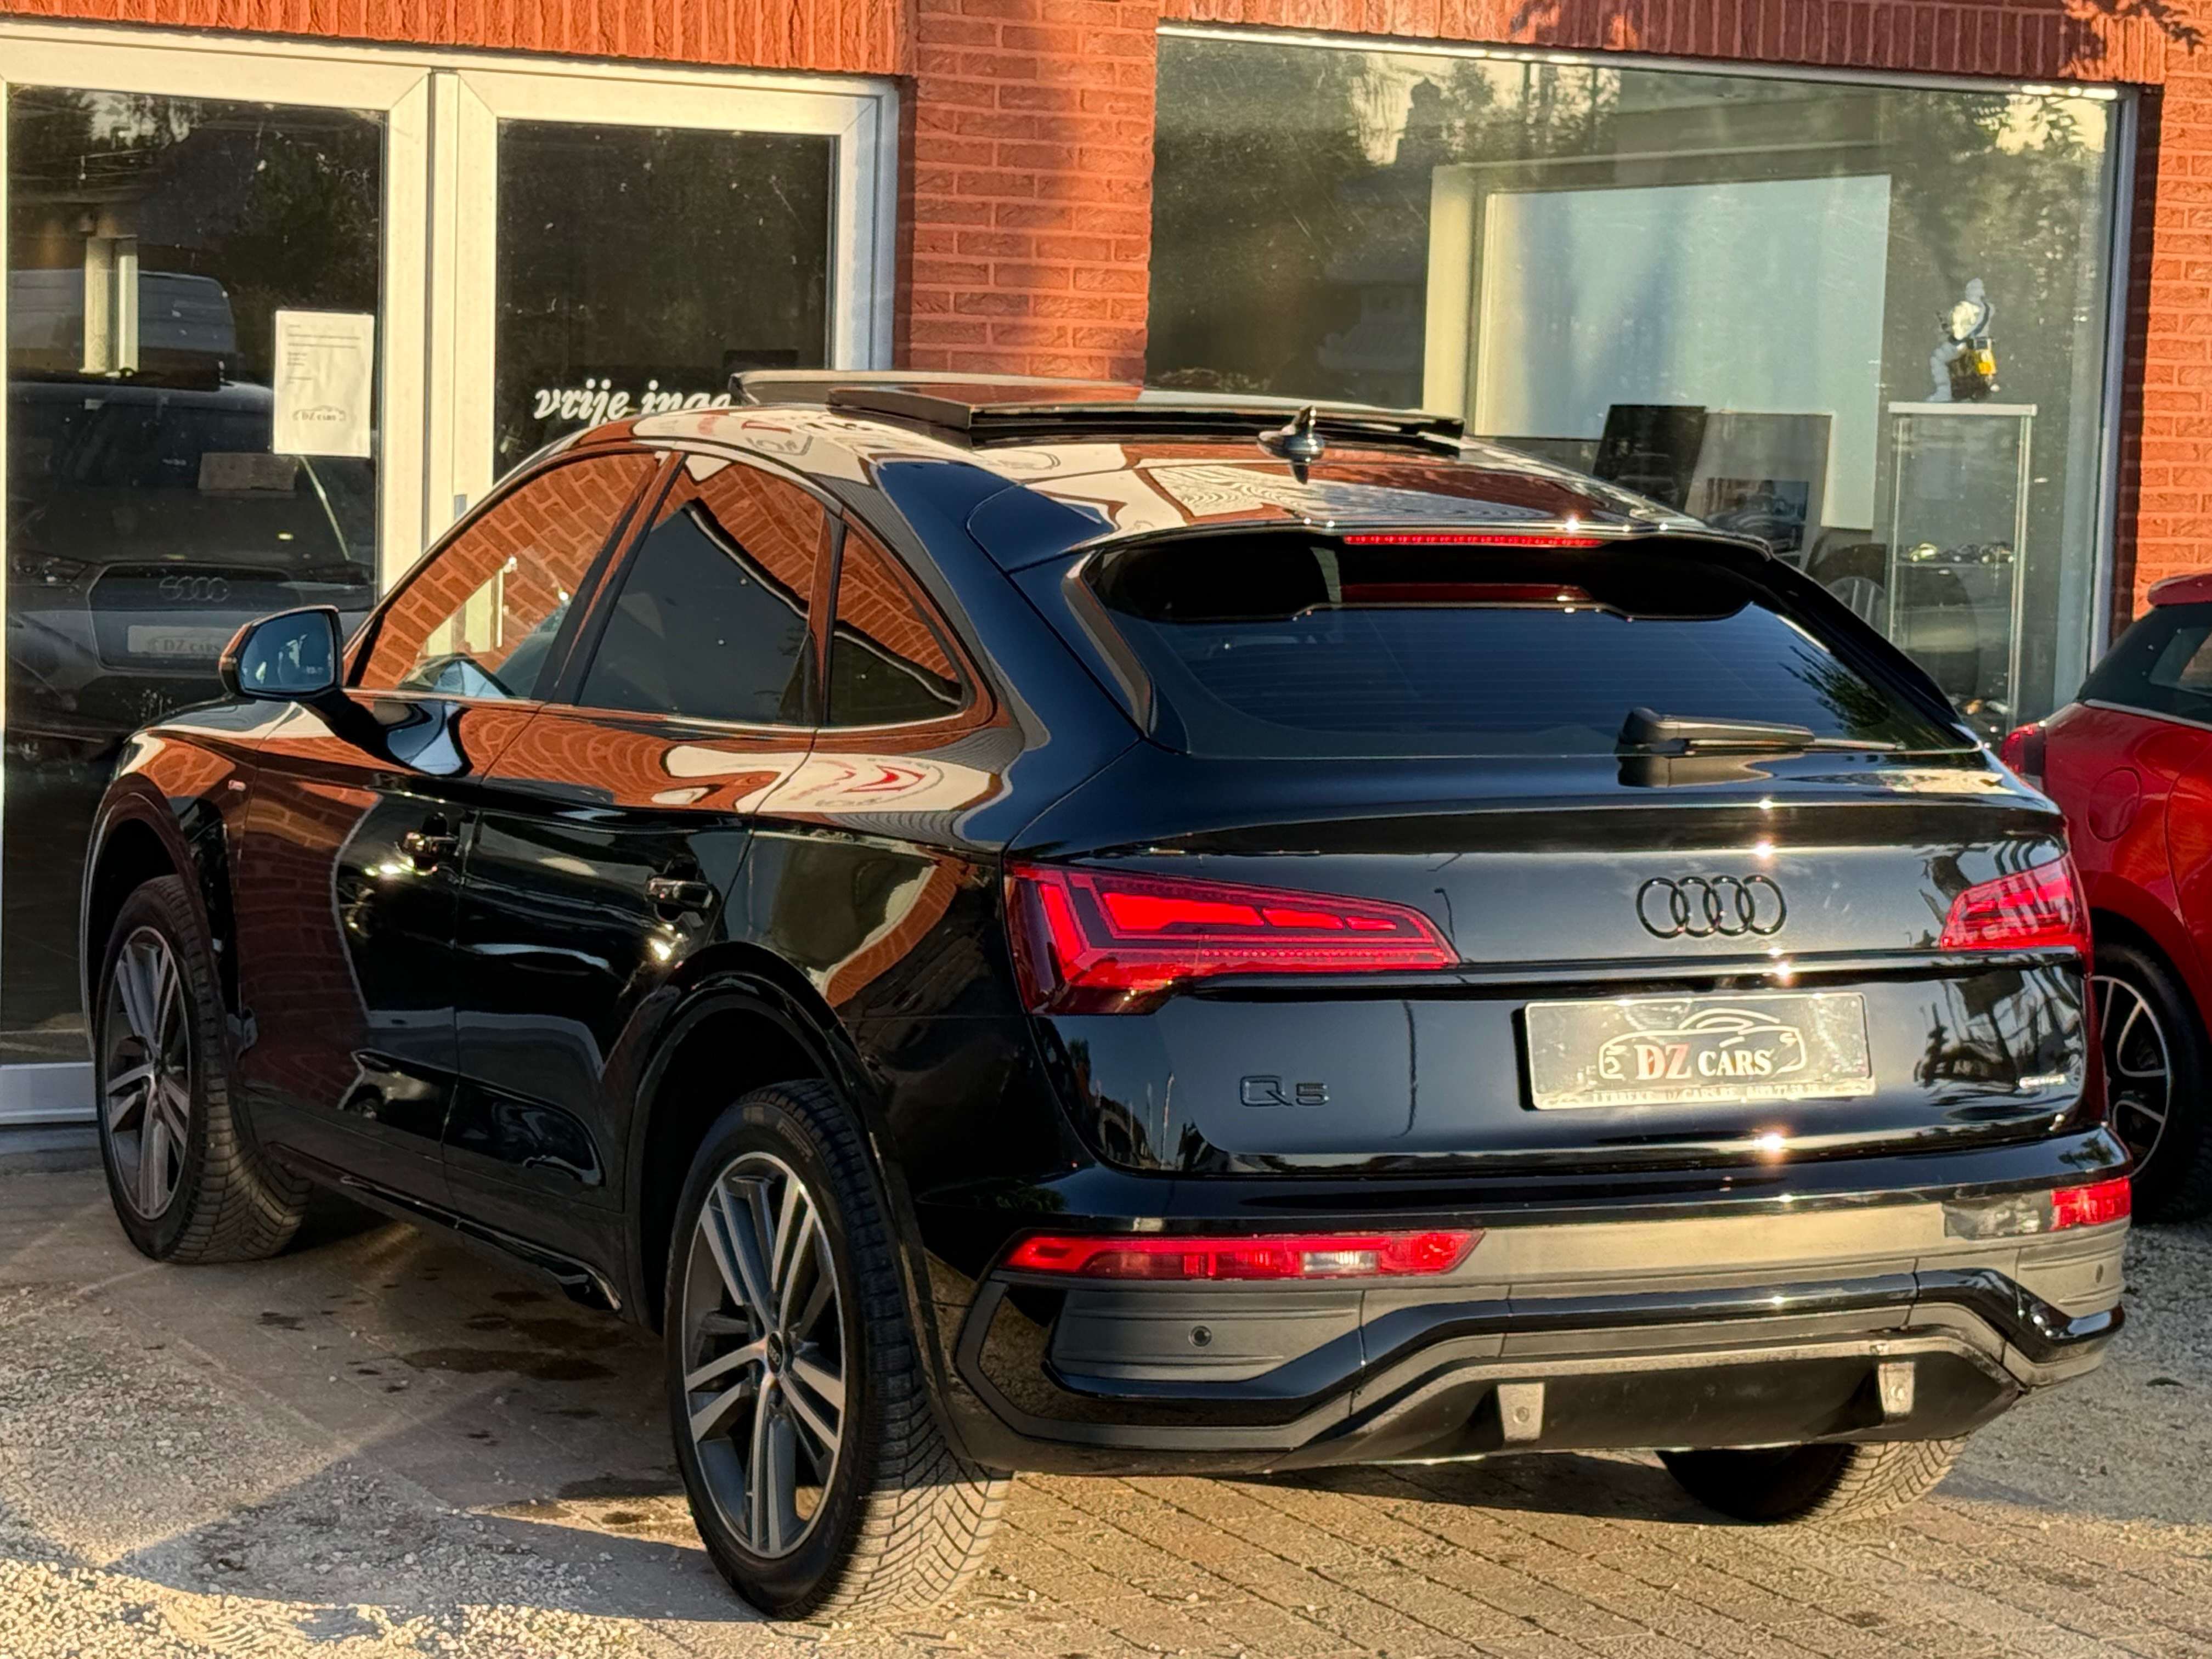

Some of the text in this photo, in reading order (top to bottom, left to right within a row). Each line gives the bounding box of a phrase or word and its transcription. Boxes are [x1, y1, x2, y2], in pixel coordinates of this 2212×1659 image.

[533, 379, 631, 427] vrije
[1633, 1042, 1775, 1080] DZ CARS
[1239, 1075, 1329, 1107] Q5
